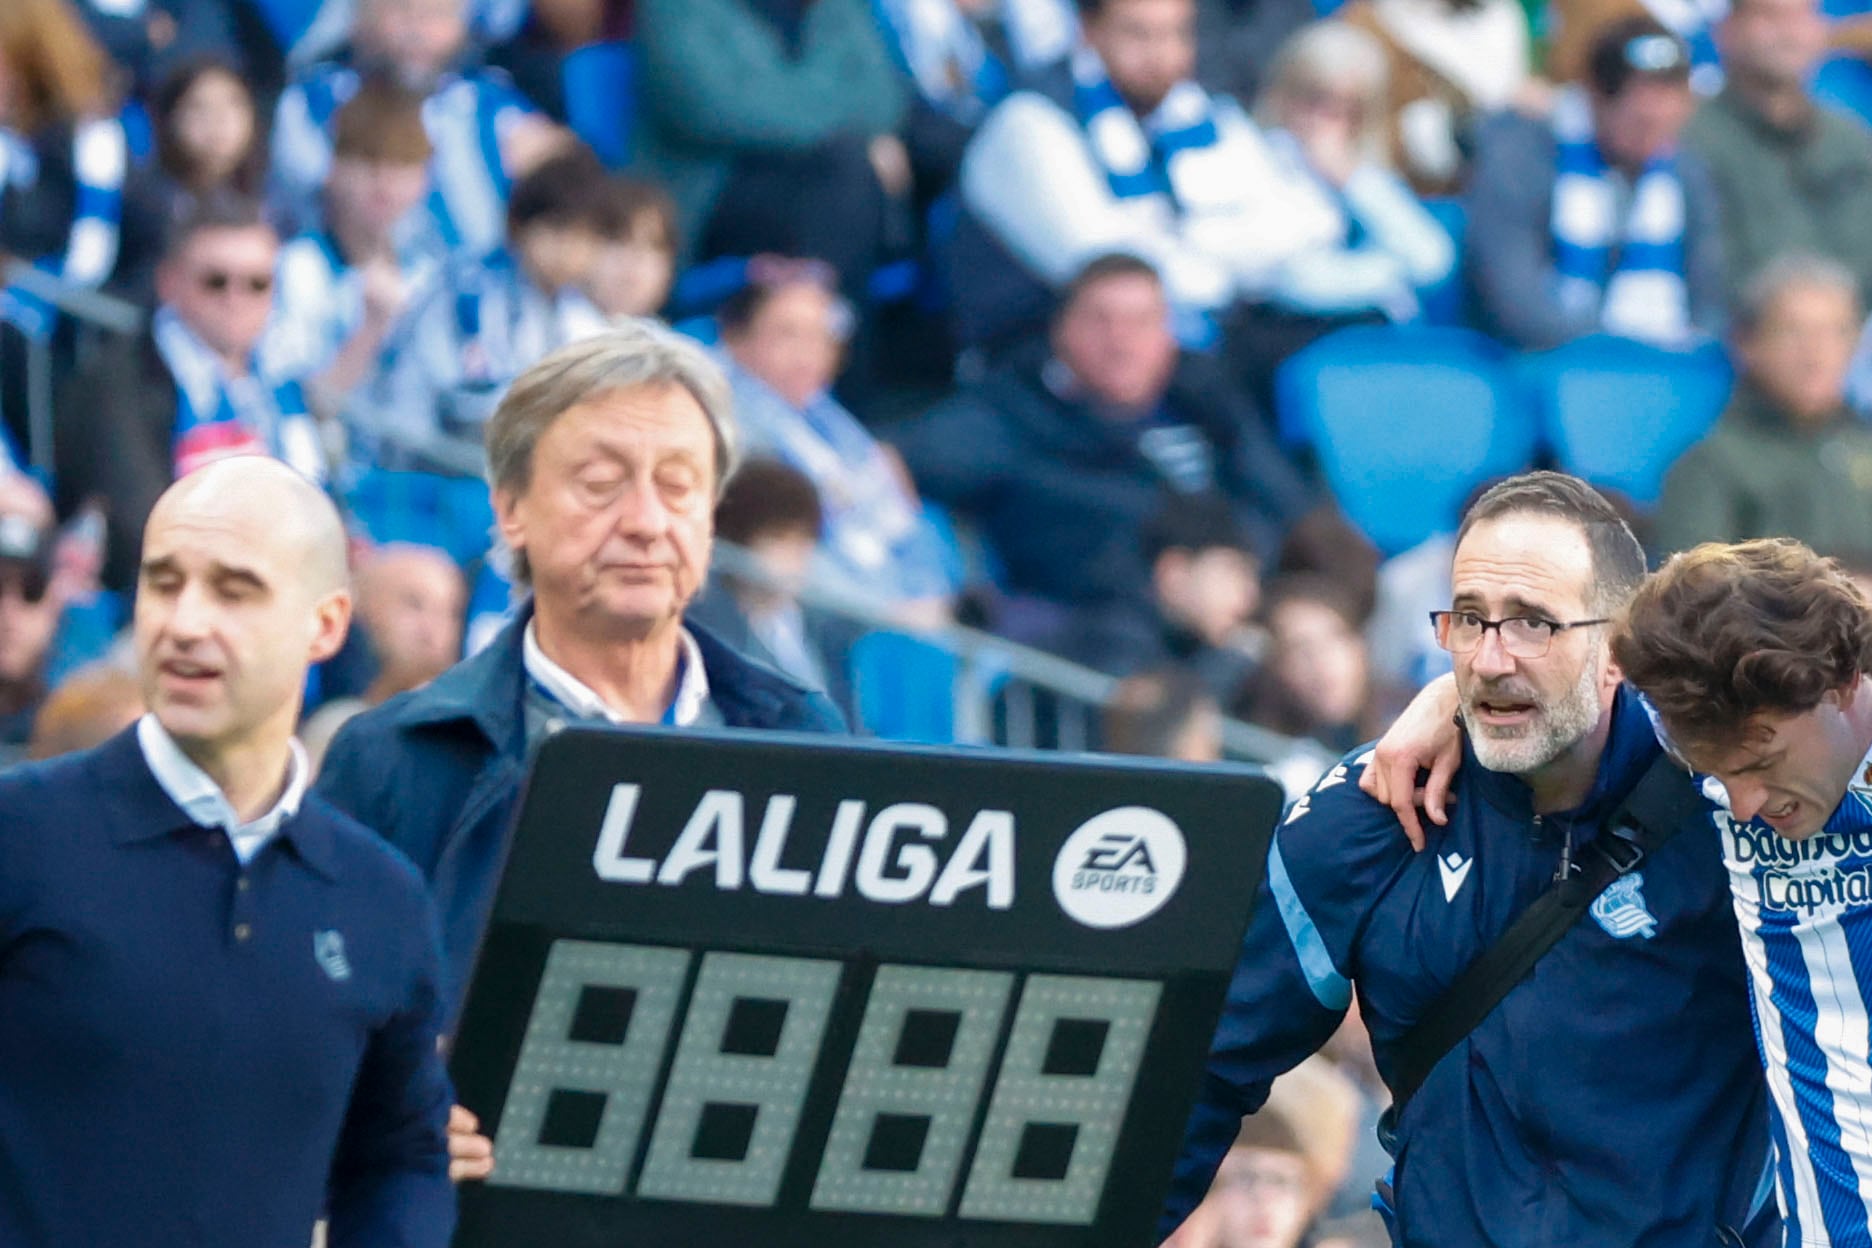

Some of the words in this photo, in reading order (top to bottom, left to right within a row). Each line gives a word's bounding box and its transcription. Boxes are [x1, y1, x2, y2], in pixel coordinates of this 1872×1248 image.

[593, 782, 1015, 910] LALIGA
[1080, 834, 1156, 874] EA
[1070, 871, 1159, 894] SPORTS
